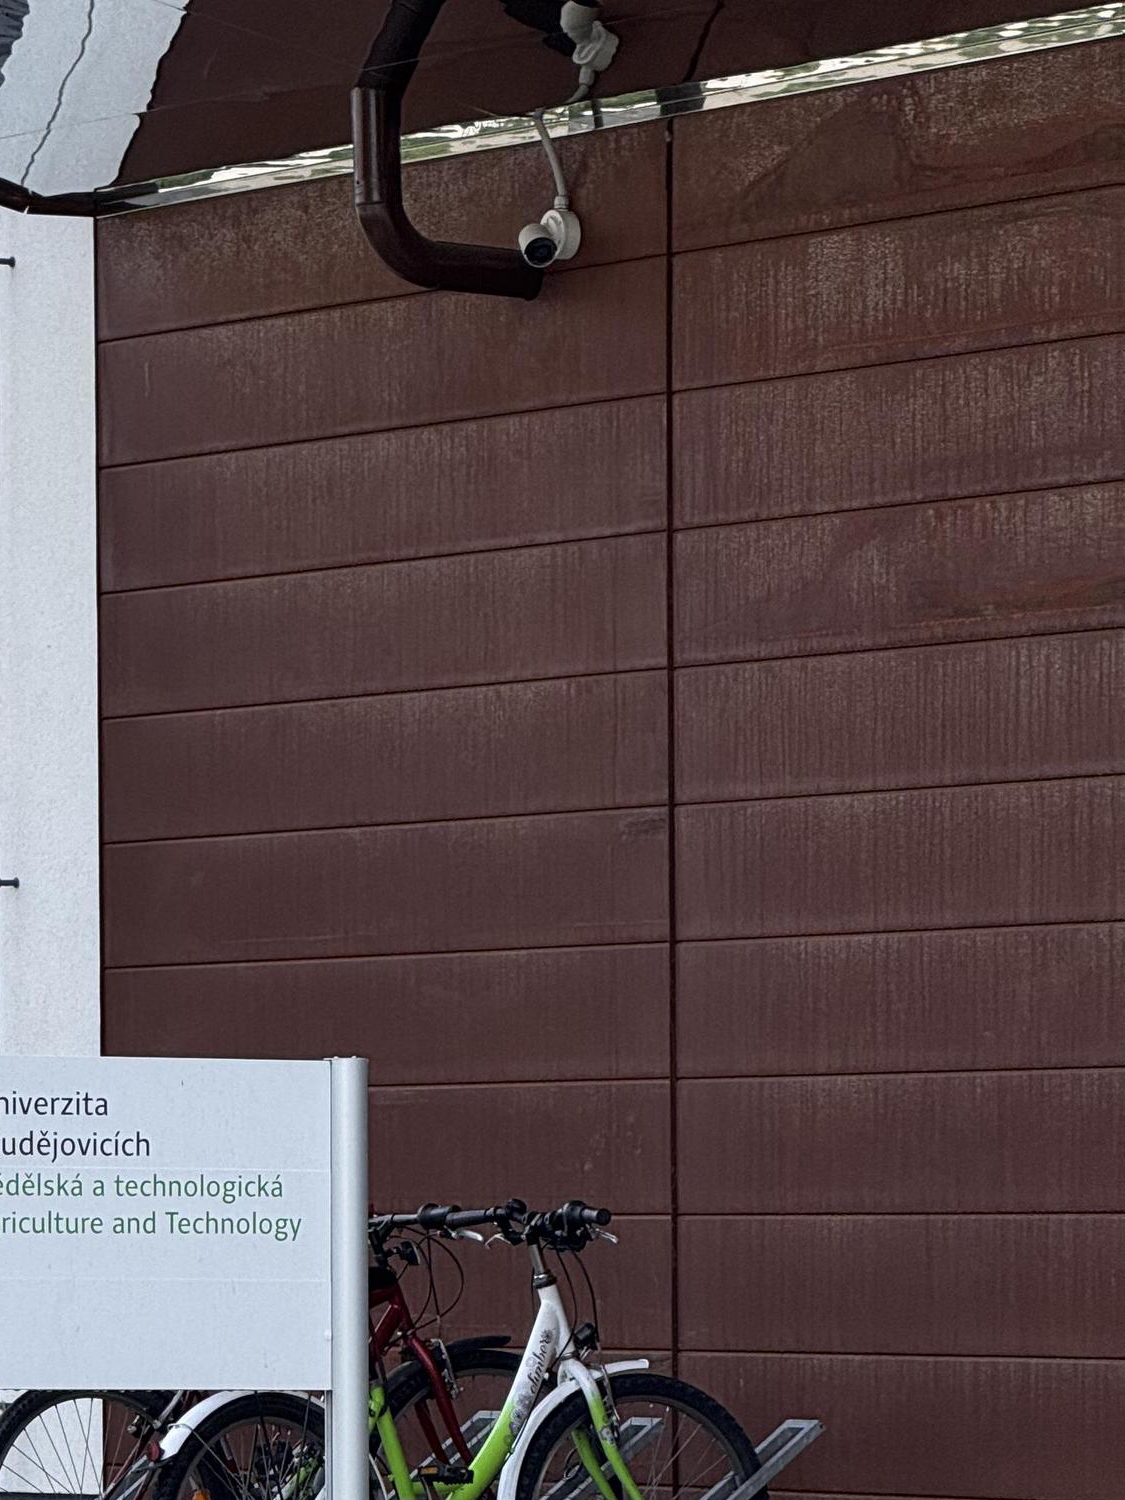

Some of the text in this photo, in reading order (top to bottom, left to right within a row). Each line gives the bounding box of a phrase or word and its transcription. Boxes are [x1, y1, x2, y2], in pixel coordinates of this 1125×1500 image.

[93, 1180, 104, 1196] a
[114, 1173, 282, 1204] technologická
[113, 1211, 156, 1234] and
[165, 1211, 301, 1241] Technology
